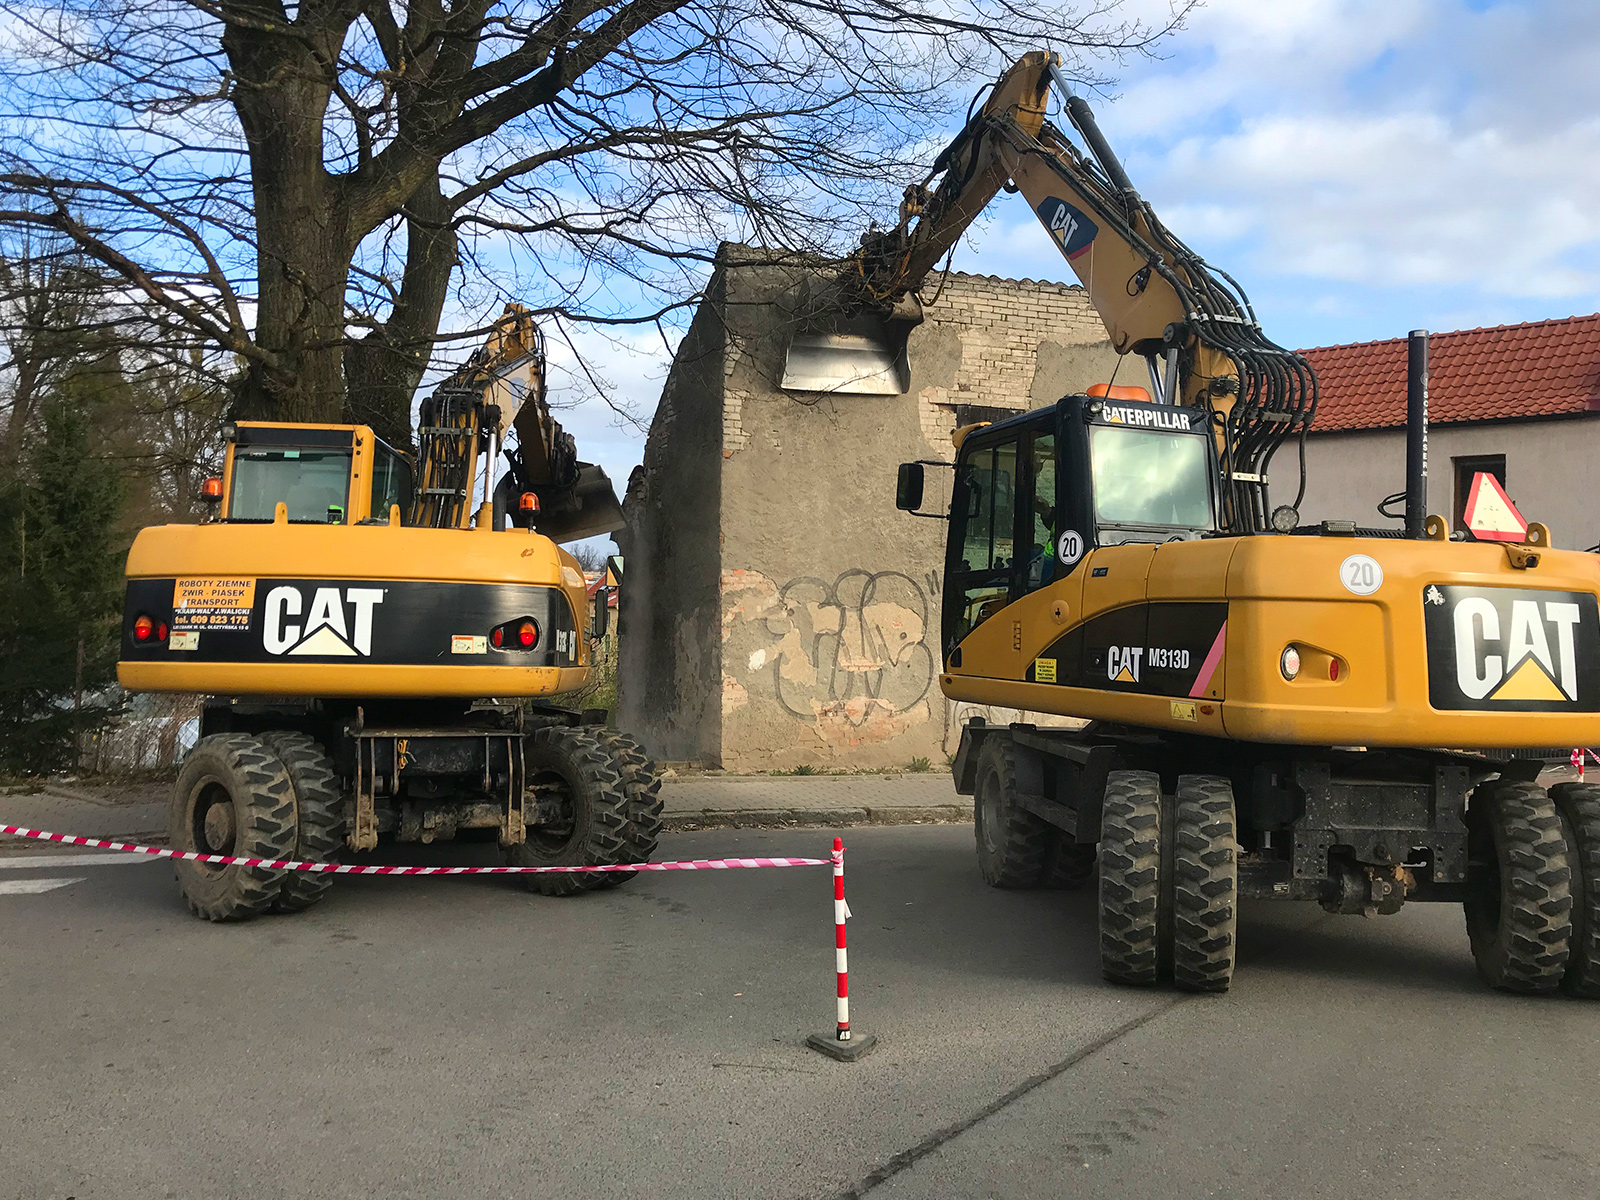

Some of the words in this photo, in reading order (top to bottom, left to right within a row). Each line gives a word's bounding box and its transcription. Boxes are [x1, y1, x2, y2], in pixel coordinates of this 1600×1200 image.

[1050, 203, 1079, 248] CAT
[1102, 406, 1191, 430] CATERPILLAR
[1062, 536, 1077, 557] 20
[179, 580, 214, 588] ROBOTY
[216, 580, 251, 588] ZIEMNE
[1349, 562, 1374, 587] 20
[186, 598, 240, 606] TRANSPORT
[211, 589, 245, 597] PIASEK
[174, 615, 189, 624] tel.
[190, 615, 208, 624] 609
[209, 615, 228, 624] 823
[230, 615, 249, 625] 175
[263, 586, 384, 656] CAT
[1453, 596, 1581, 702] CAT
[1107, 645, 1143, 683] CAT
[1148, 648, 1190, 669] M313D
